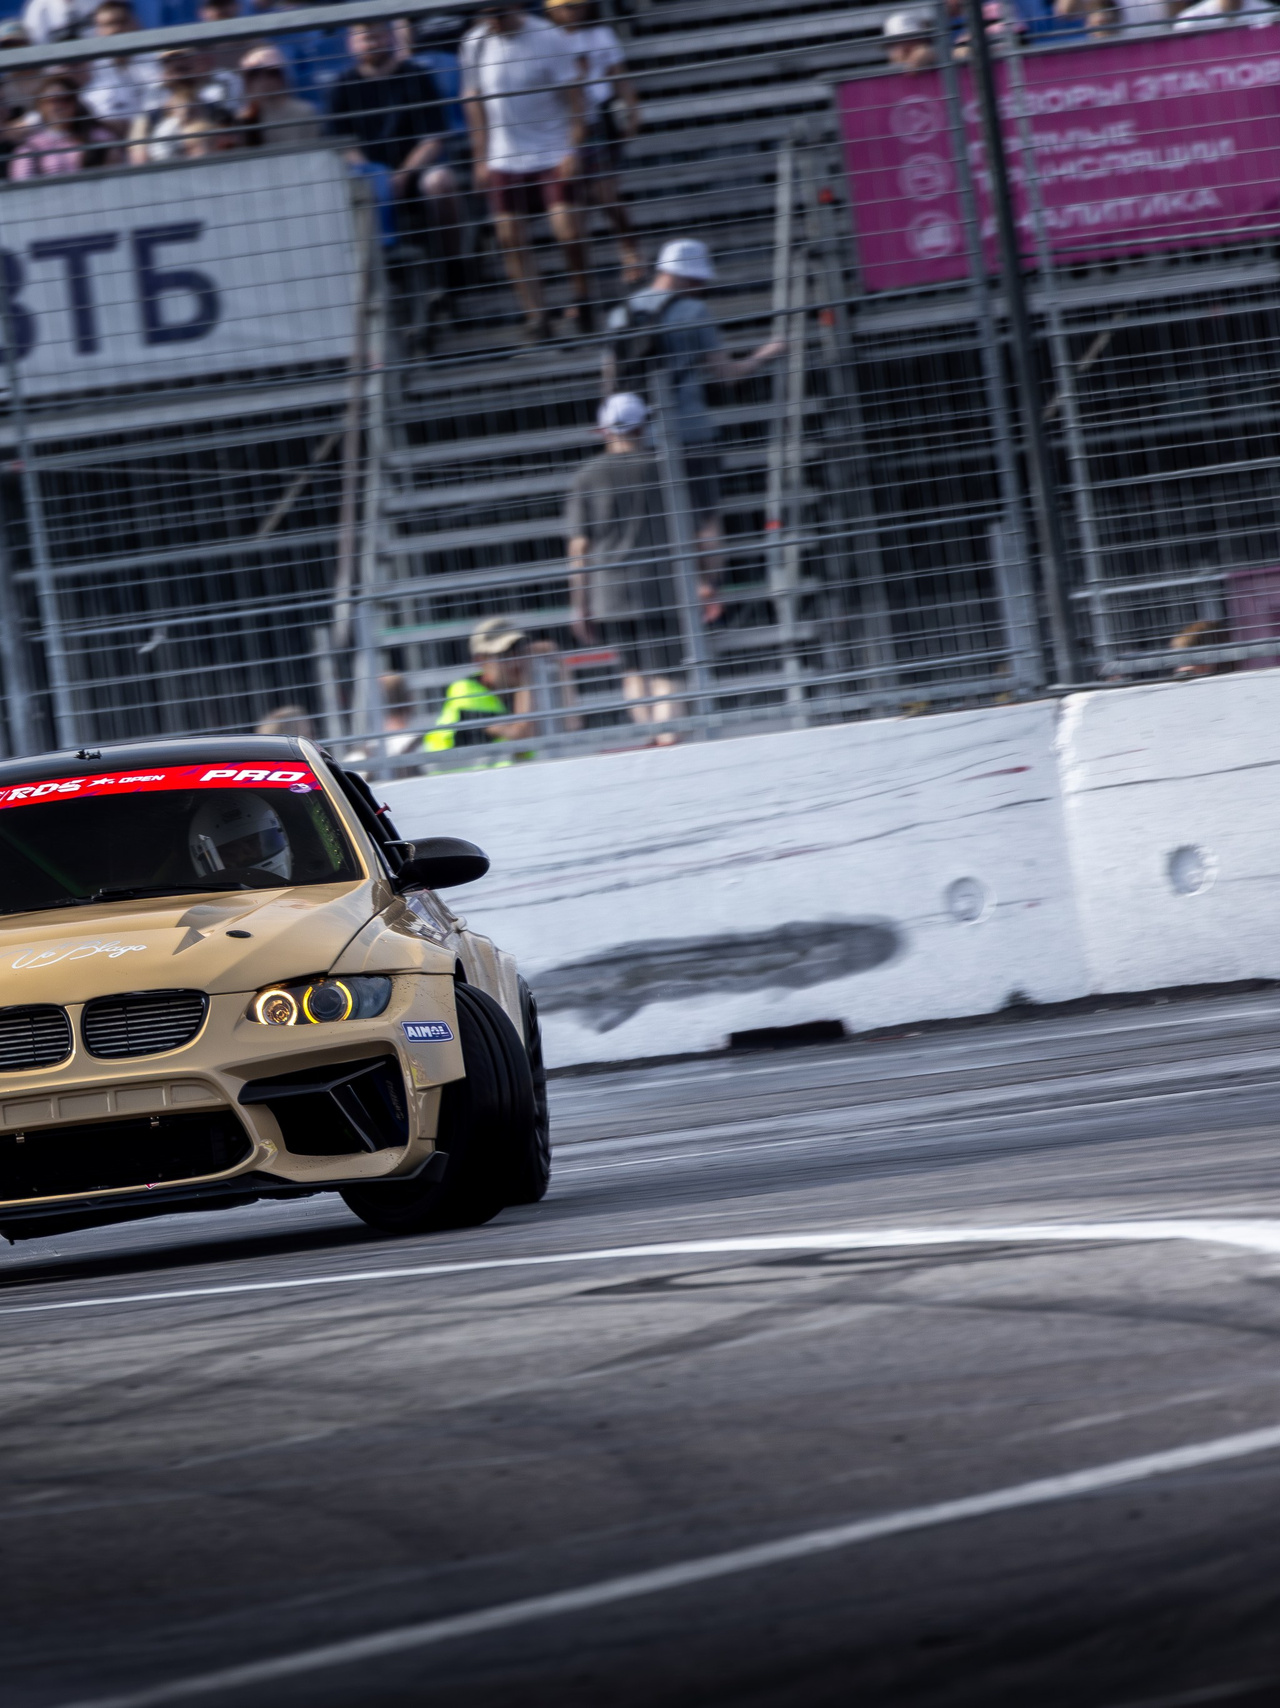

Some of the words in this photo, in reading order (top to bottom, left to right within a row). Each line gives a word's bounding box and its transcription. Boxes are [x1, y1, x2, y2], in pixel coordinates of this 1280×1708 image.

[199, 769, 306, 782] PRO
[6, 779, 86, 801] RDS
[118, 774, 166, 783] OPEN
[407, 1025, 450, 1038] AIMOL
